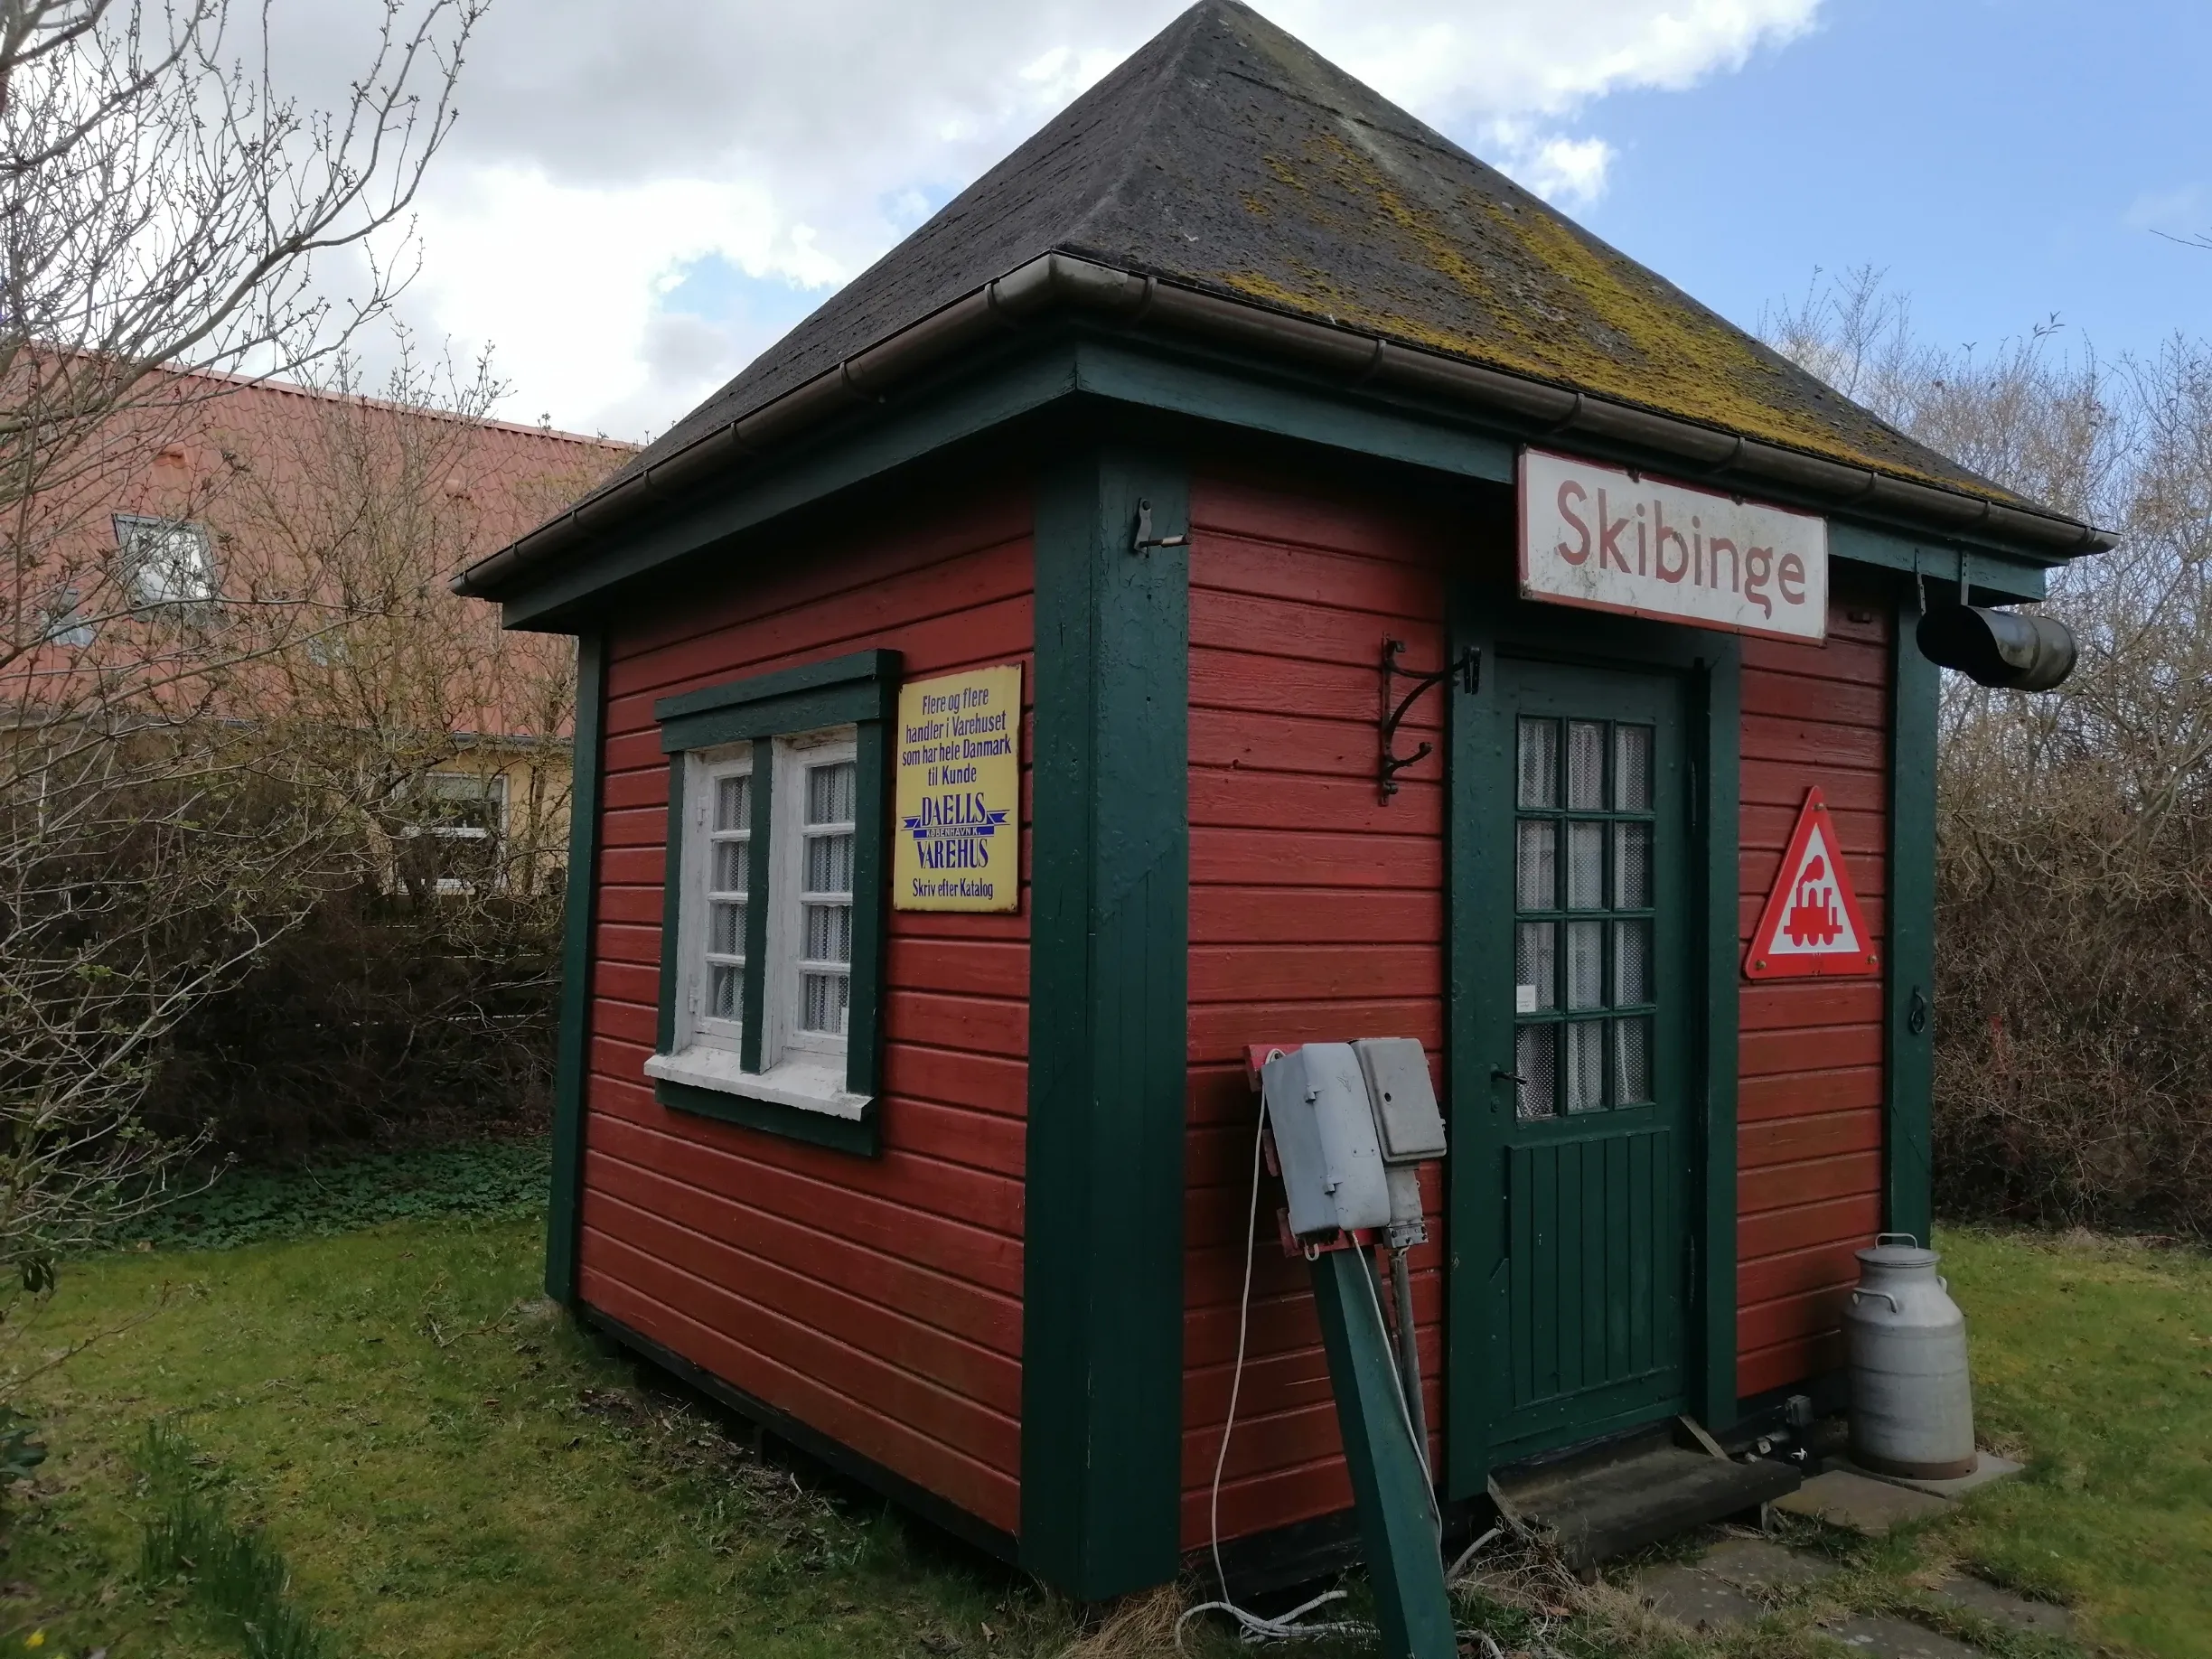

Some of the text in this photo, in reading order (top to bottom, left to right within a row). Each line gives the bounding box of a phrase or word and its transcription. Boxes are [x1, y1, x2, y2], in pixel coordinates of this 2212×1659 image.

[1557, 480, 1805, 620] Skibinge
[923, 688, 989, 715] Flere og flere
[906, 710, 1007, 744] handler i Varehuset
[902, 734, 1011, 766] som har hele Danmark
[928, 763, 977, 786] til Kunde
[922, 792, 986, 826] DAELLS
[926, 827, 971, 838] KØBENHAVN
[917, 839, 989, 868] VAREHUS
[913, 877, 993, 900] Skriv efter Katalog
